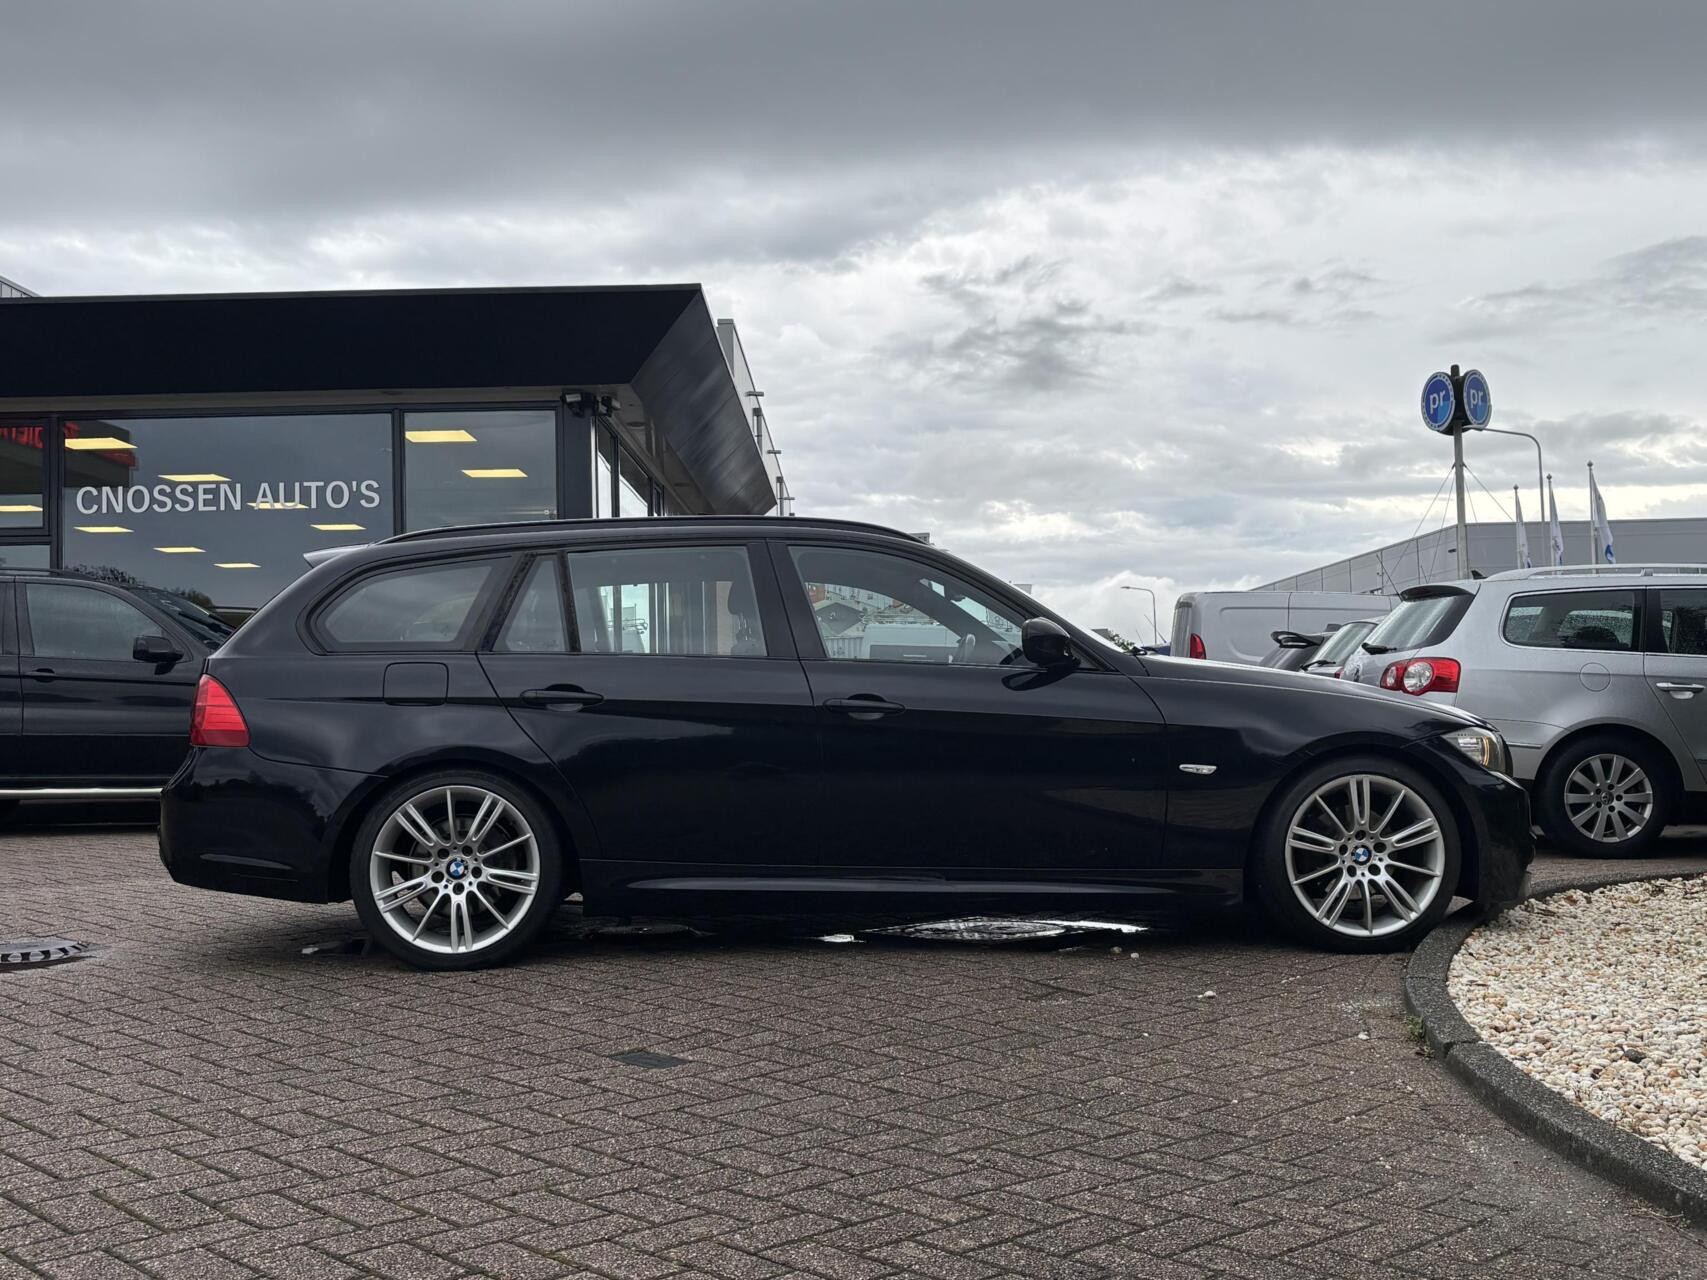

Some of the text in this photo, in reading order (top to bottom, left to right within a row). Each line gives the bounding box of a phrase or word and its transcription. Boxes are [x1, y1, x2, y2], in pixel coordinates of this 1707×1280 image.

[1429, 390, 1446, 415] pr
[1470, 388, 1484, 409] pr
[76, 480, 380, 514] CNOSSEN AUTO'S
